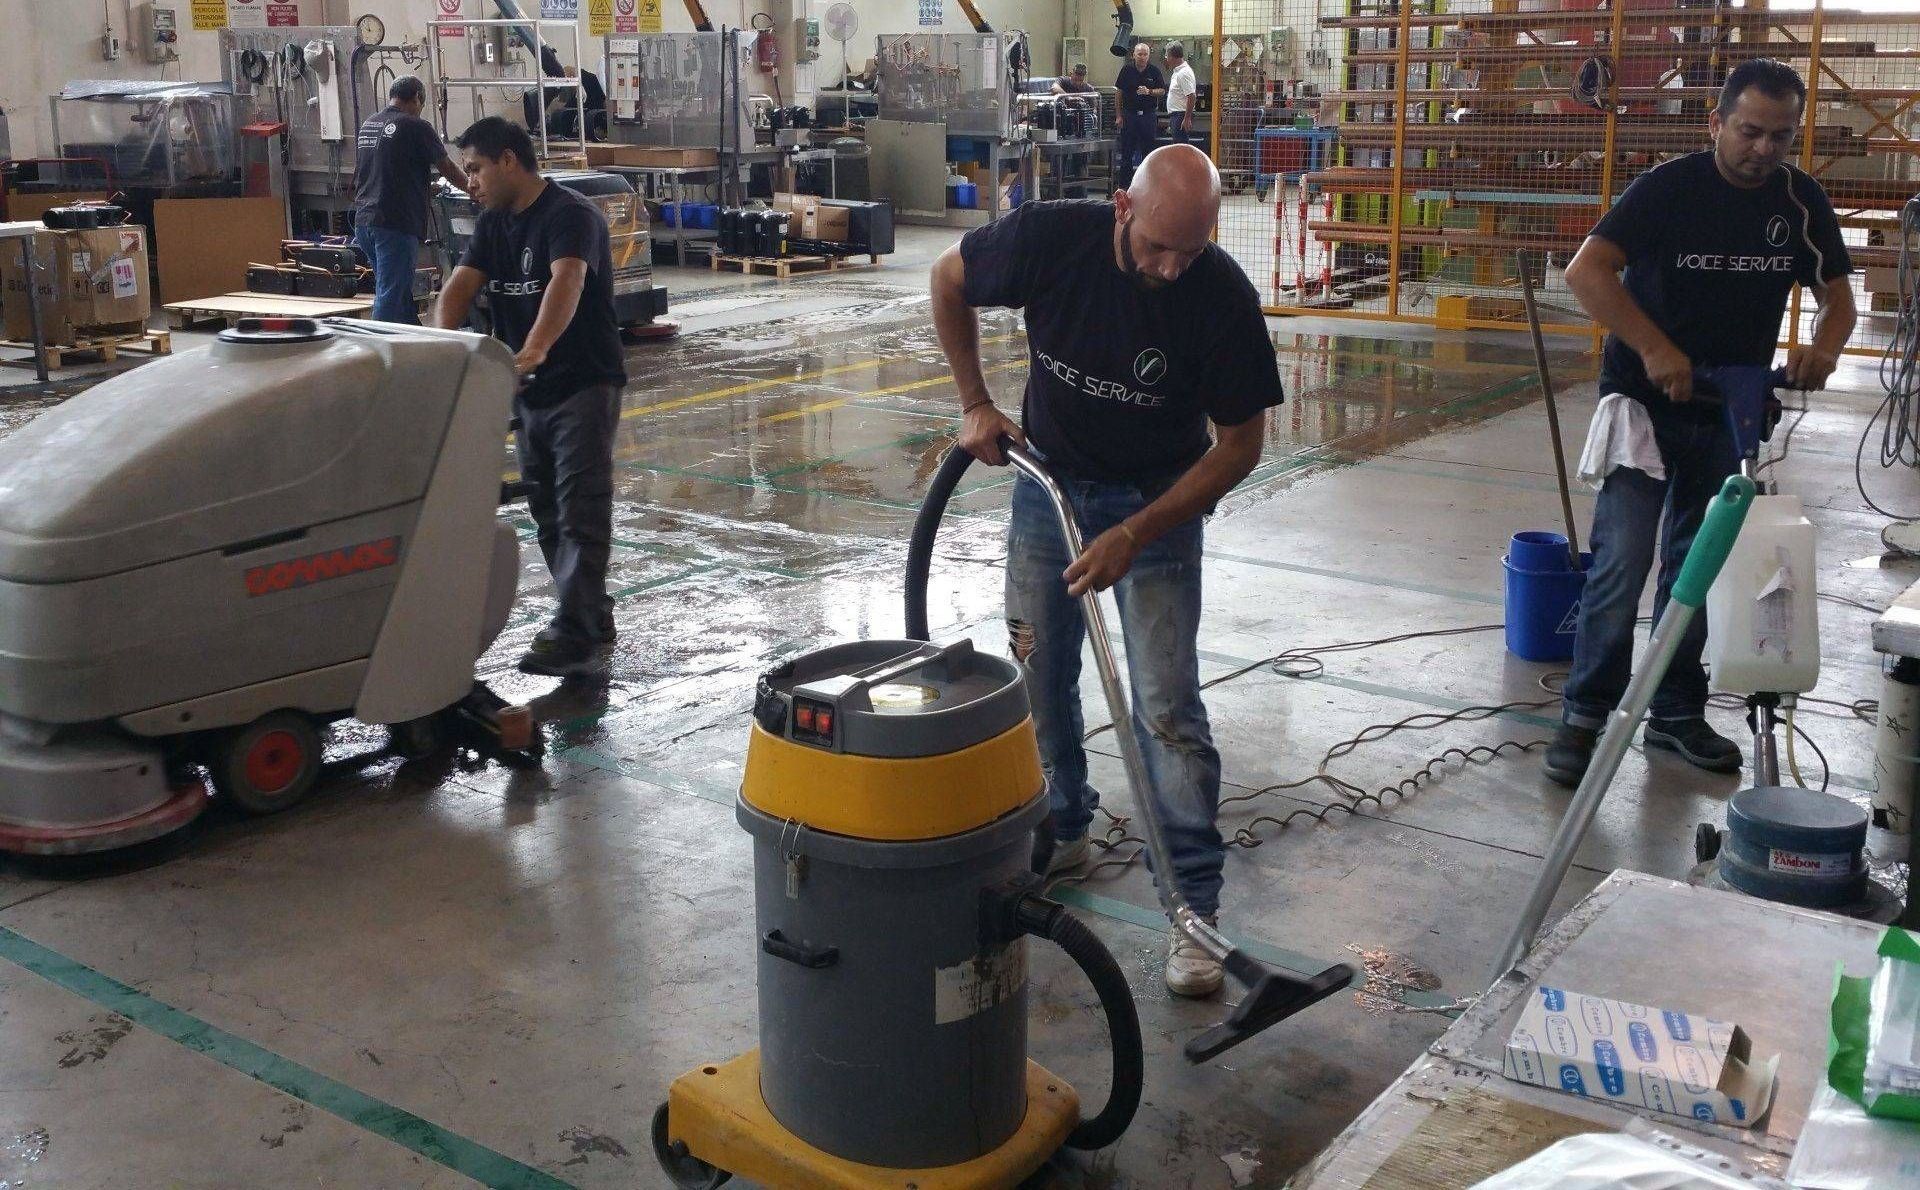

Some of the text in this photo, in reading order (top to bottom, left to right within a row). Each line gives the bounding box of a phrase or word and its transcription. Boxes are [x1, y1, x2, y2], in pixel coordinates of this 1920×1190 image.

[1676, 254, 1793, 271] VOICE SERVICE
[1082, 375, 1166, 407] SERVICE
